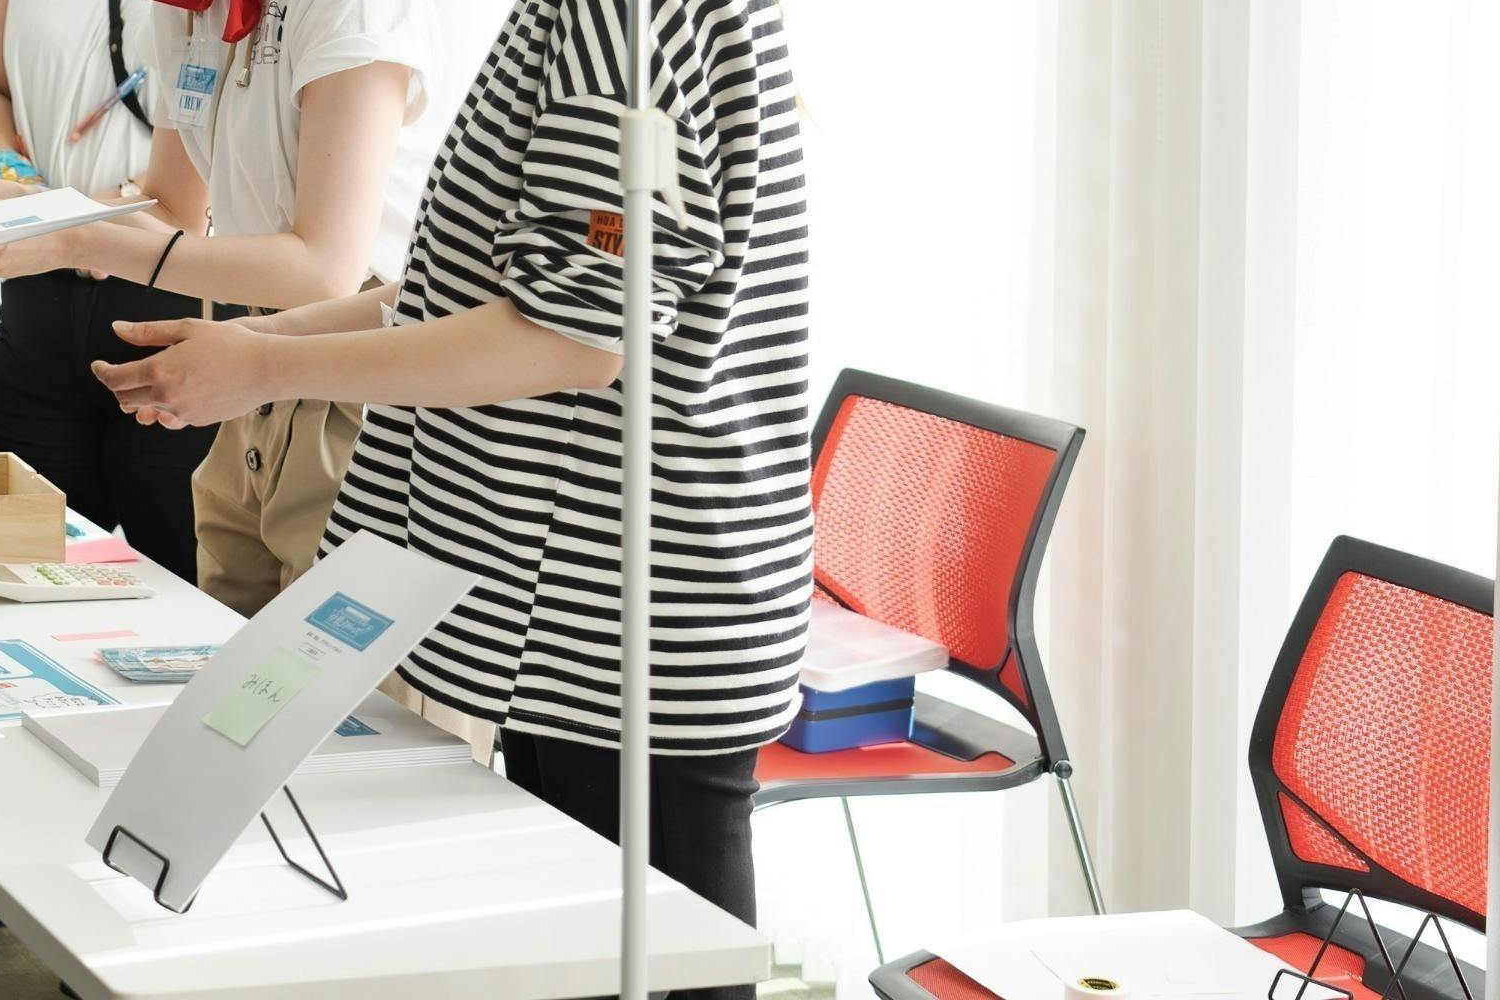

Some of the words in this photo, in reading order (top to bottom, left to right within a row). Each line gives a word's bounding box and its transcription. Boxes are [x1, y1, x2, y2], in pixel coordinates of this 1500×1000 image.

[180, 94, 203, 112] CREW
[242, 673, 284, 703] みほん
